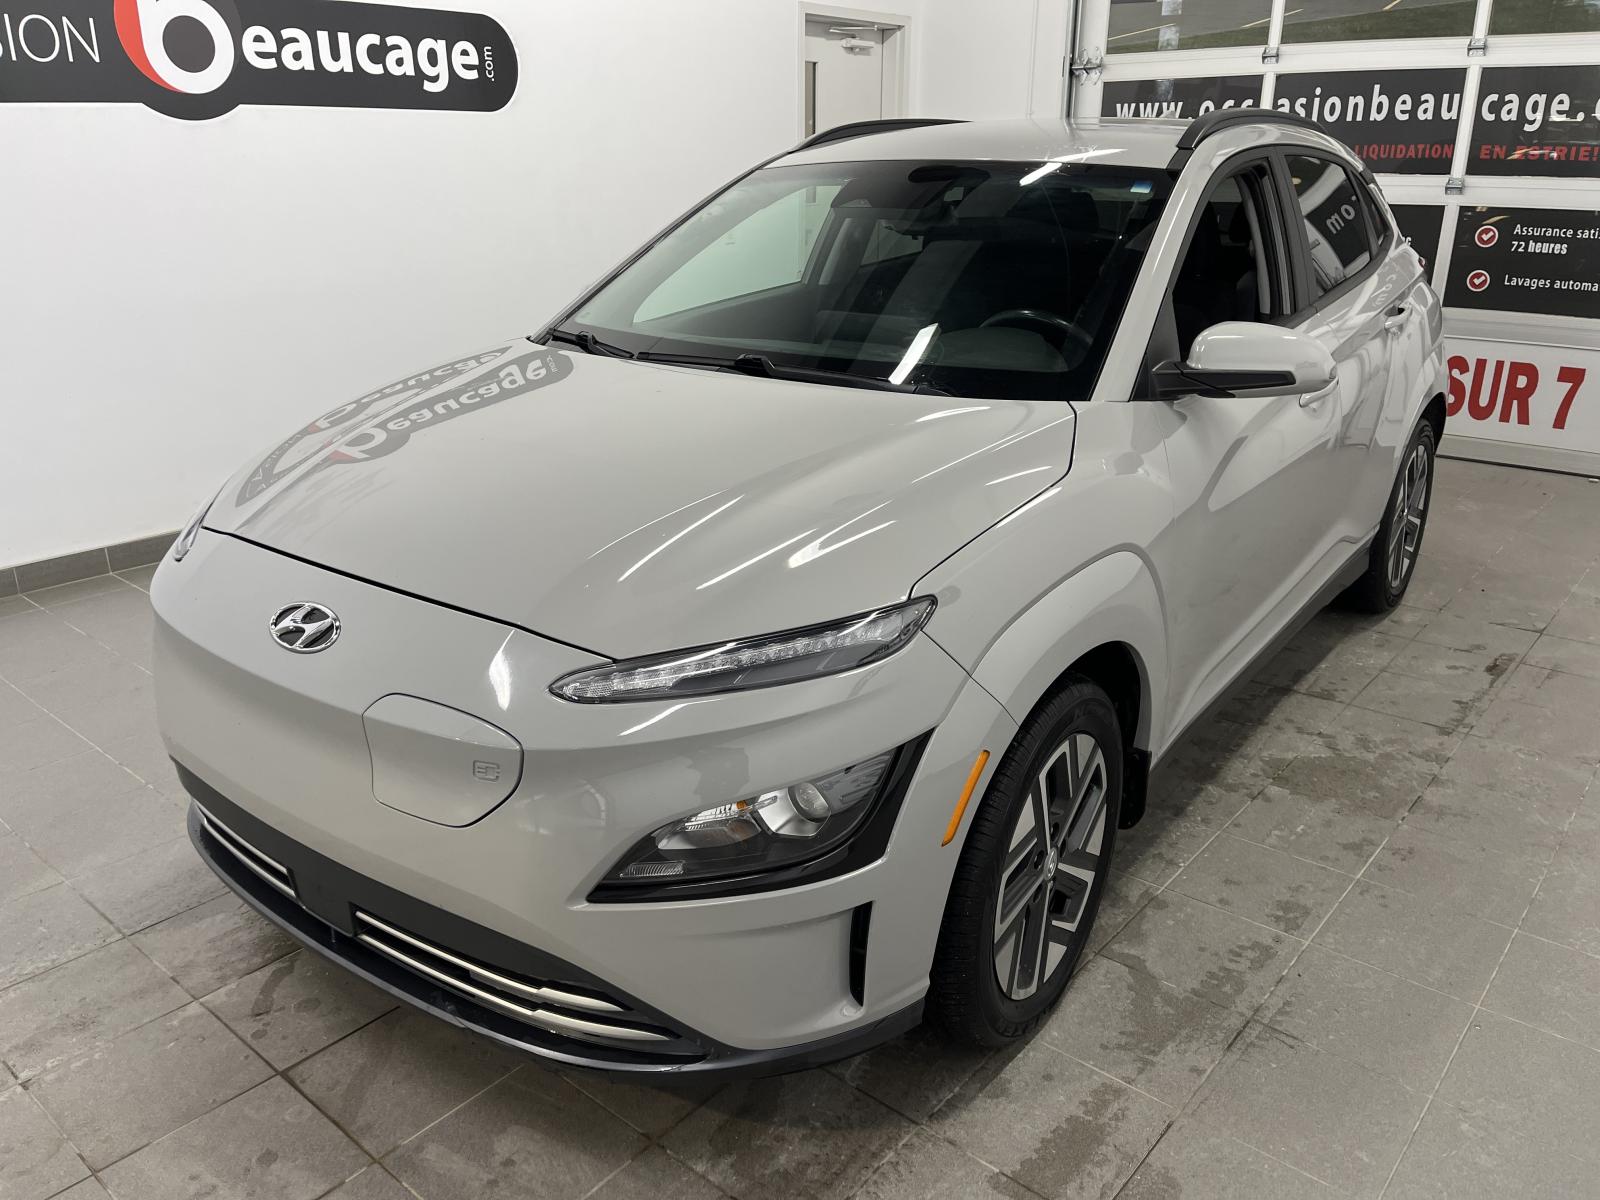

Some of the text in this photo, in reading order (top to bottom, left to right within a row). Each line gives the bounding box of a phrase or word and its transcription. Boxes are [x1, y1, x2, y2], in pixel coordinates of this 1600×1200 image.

[0, 13, 100, 63] ION
[483, 46, 495, 82] .com
[1354, 143, 1600, 162] LIQUIDATION EN ESTRIE!
[1513, 224, 1600, 240] Assurance sati
[1511, 239, 1568, 255] 72 heures
[1504, 274, 1599, 292] Lavages automa
[1446, 355, 1586, 430] SUR 7
